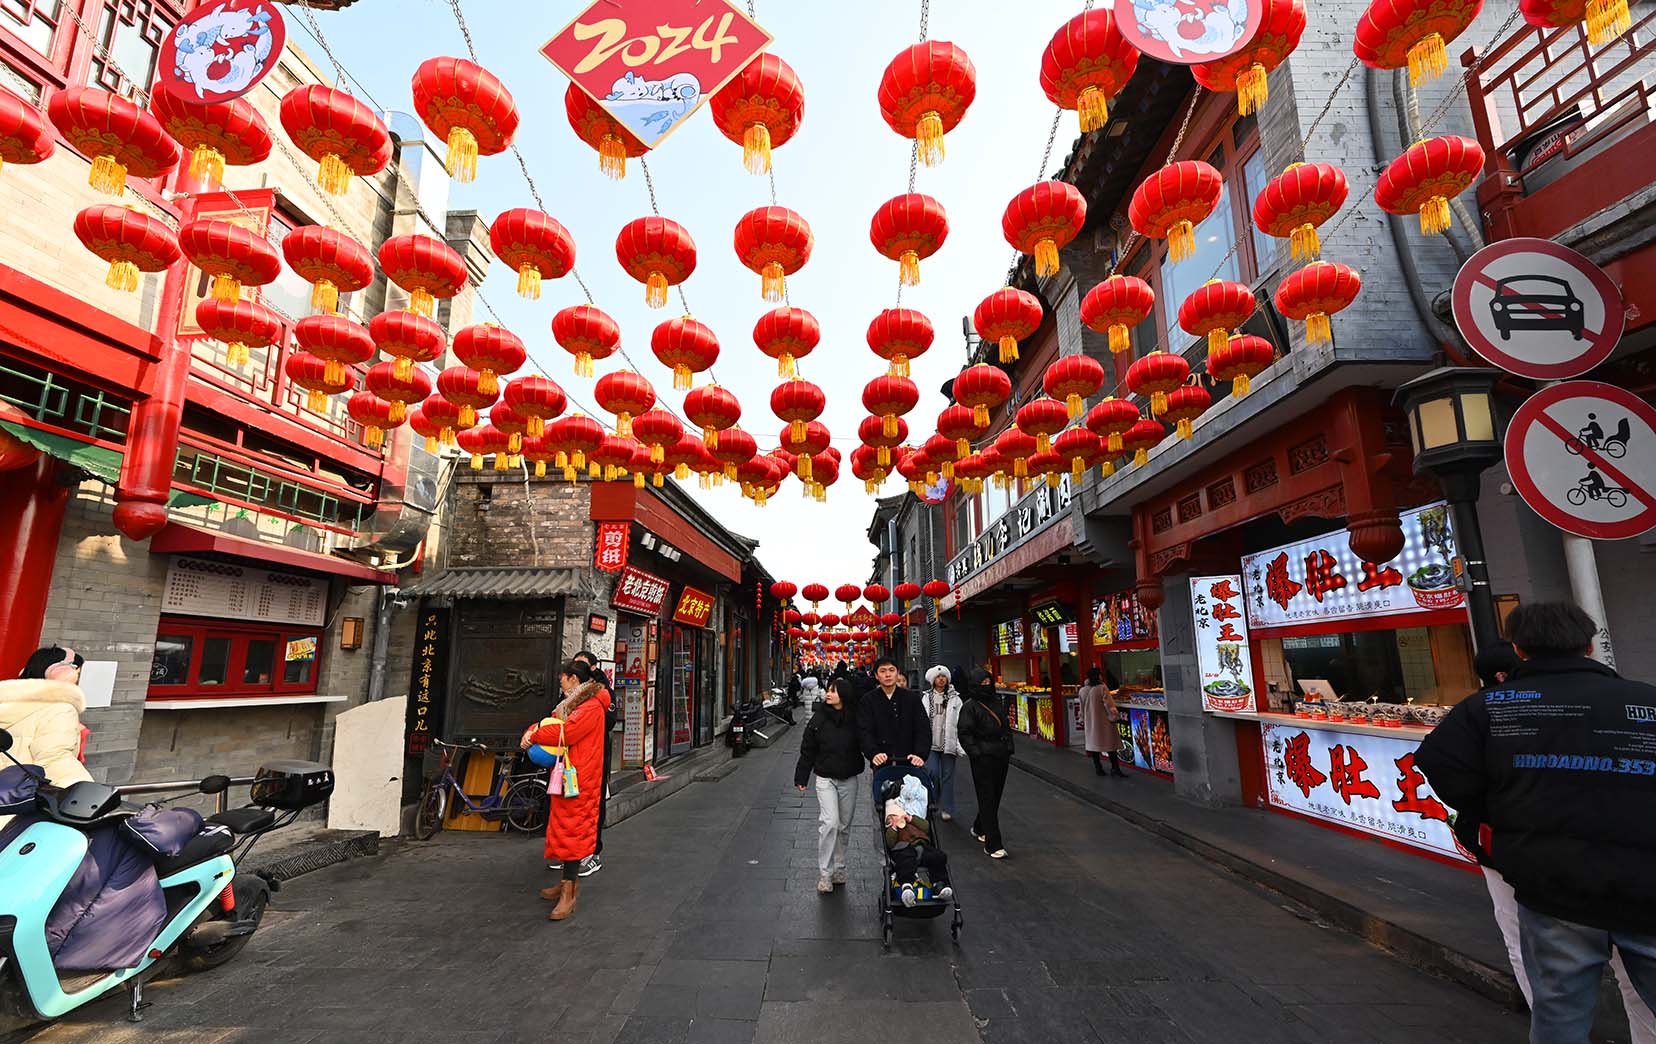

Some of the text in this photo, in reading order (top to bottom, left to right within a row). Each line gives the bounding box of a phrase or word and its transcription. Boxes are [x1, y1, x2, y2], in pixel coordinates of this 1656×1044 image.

[573, 12, 739, 74] 2024
[602, 530, 624, 564] 剪纸
[678, 594, 711, 619] 北京特产
[1195, 593, 1210, 629] 老北京
[1210, 579, 1244, 641] 爆肚王
[1252, 569, 1265, 608] 老北京
[415, 614, 438, 731] 只此北京有这口儿
[1272, 739, 1285, 785] 老北京
[1284, 731, 1448, 822] 爆肚王
